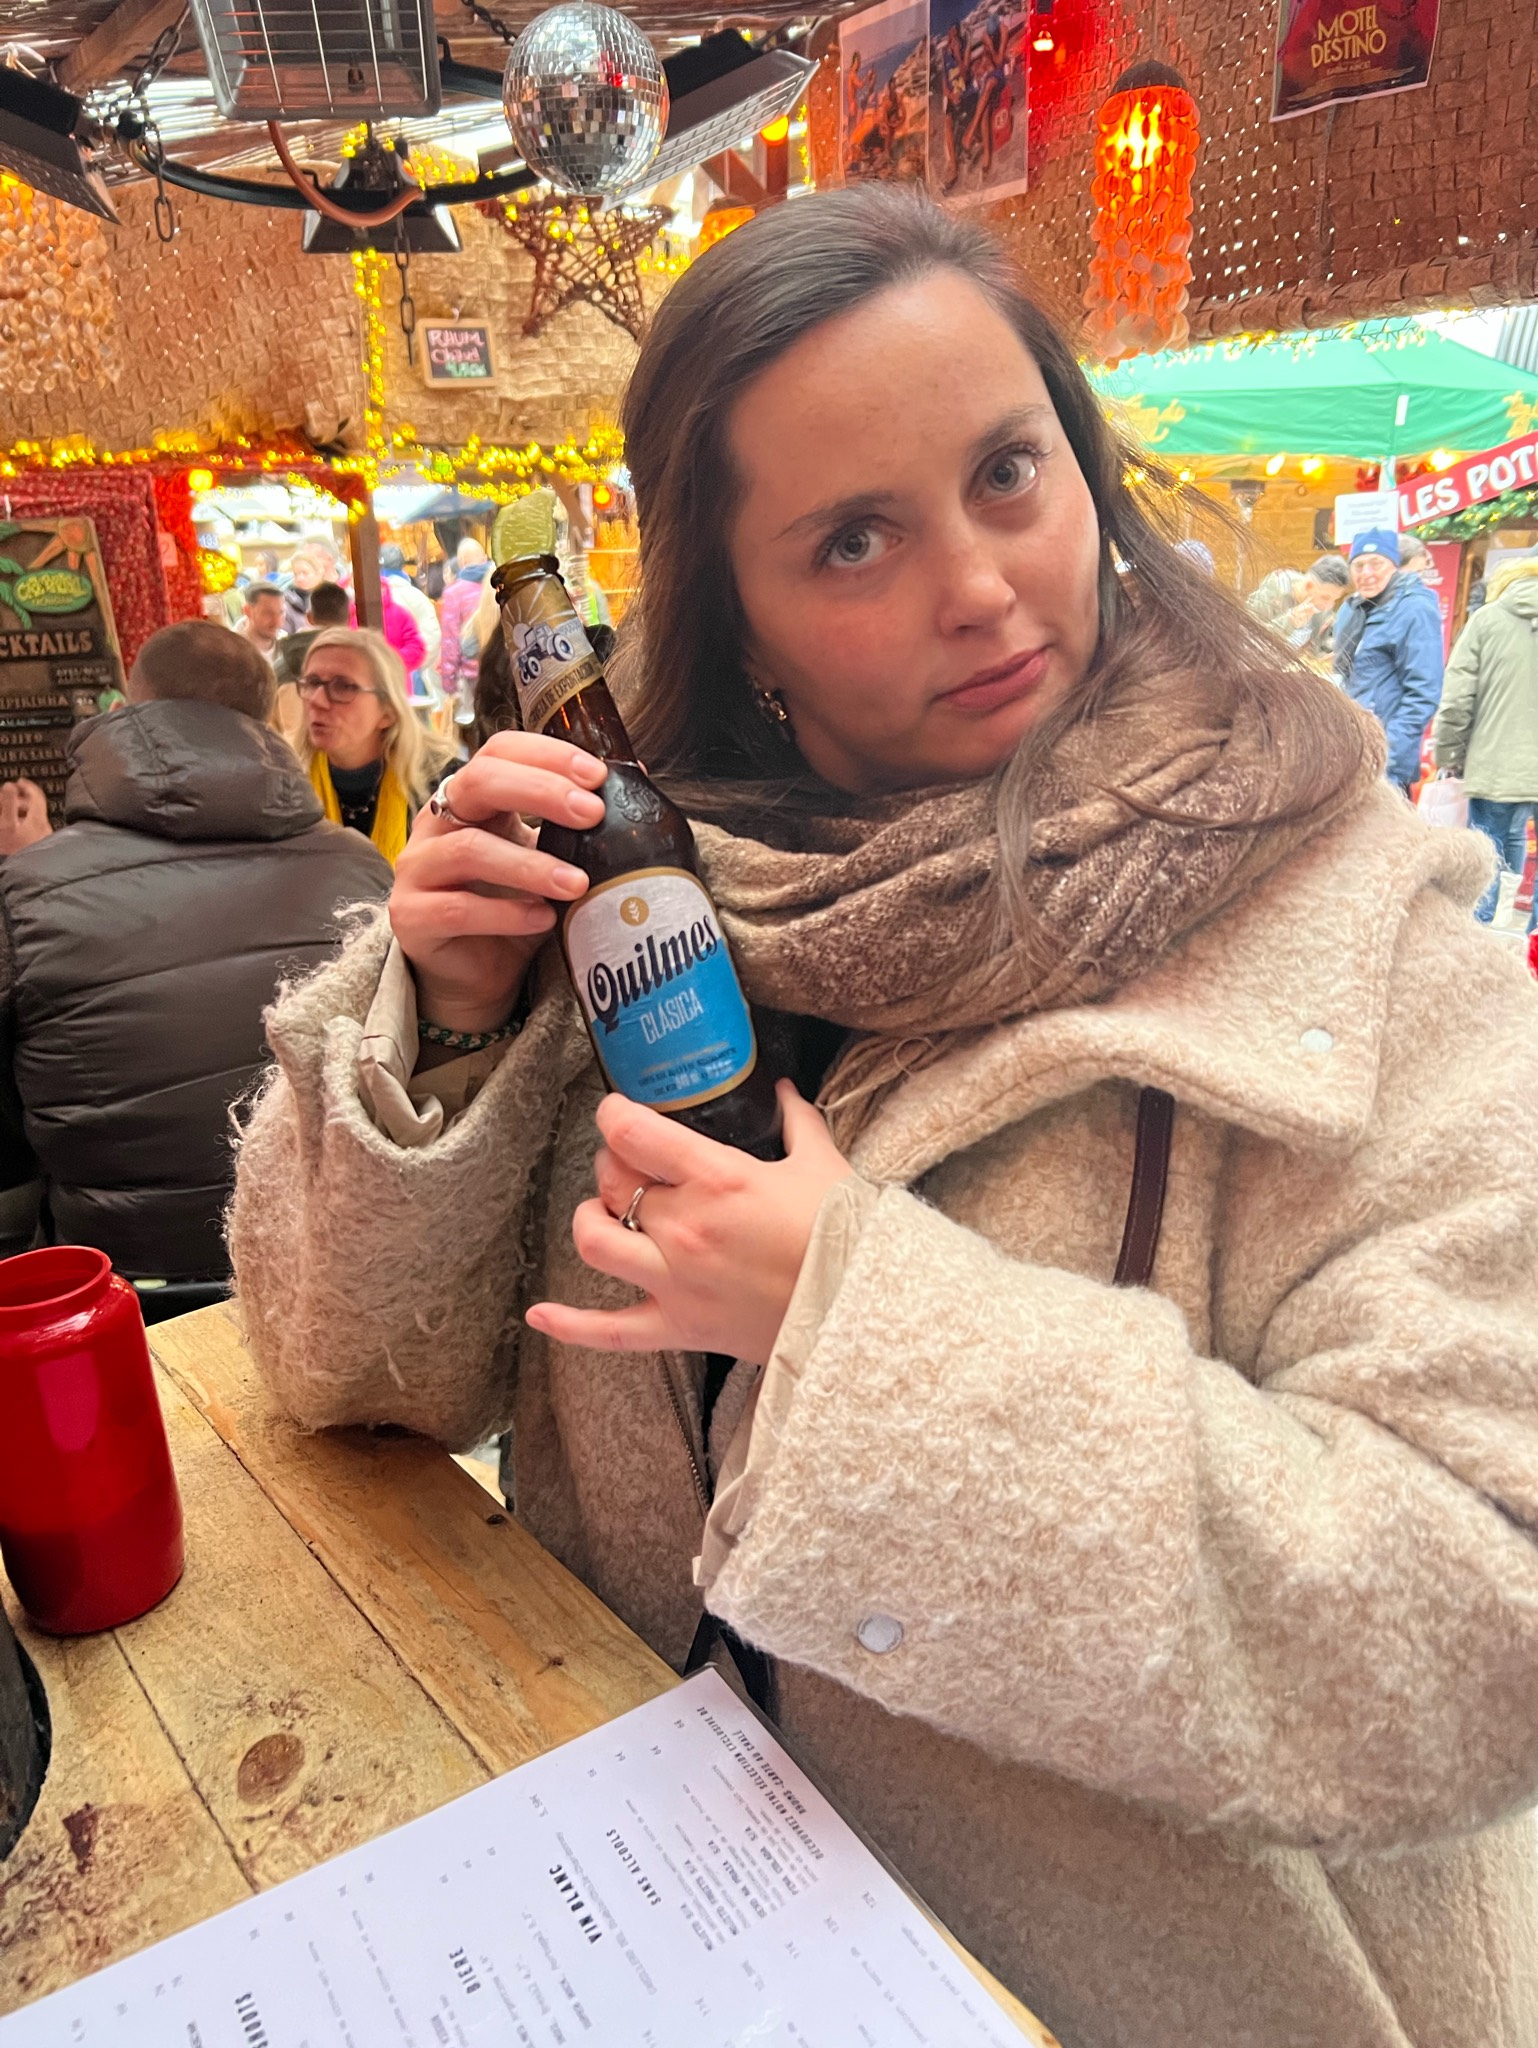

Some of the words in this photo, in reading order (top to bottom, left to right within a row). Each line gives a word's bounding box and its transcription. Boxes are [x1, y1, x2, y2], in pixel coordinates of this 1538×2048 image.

[1317, 5, 1378, 41] MOTEL
[1310, 29, 1387, 69] DESTINO
[1400, 477, 1460, 526] LES
[1466, 441, 1538, 500] POT
[587, 915, 718, 1036] Quilmes
[696, 1706, 709, 1717] DE
[704, 1715, 737, 1752] EXCLUSIVE
[733, 1752, 768, 1790] SÉLECTION
[764, 1790, 788, 1815] NOTRE
[605, 1828, 641, 1875] ALCOOLS
[784, 1815, 825, 1861] DÉCOUVREZ
[549, 1864, 585, 1913] BLANC
[637, 1876, 662, 1906] SANS
[578, 1914, 603, 1944] VIN
